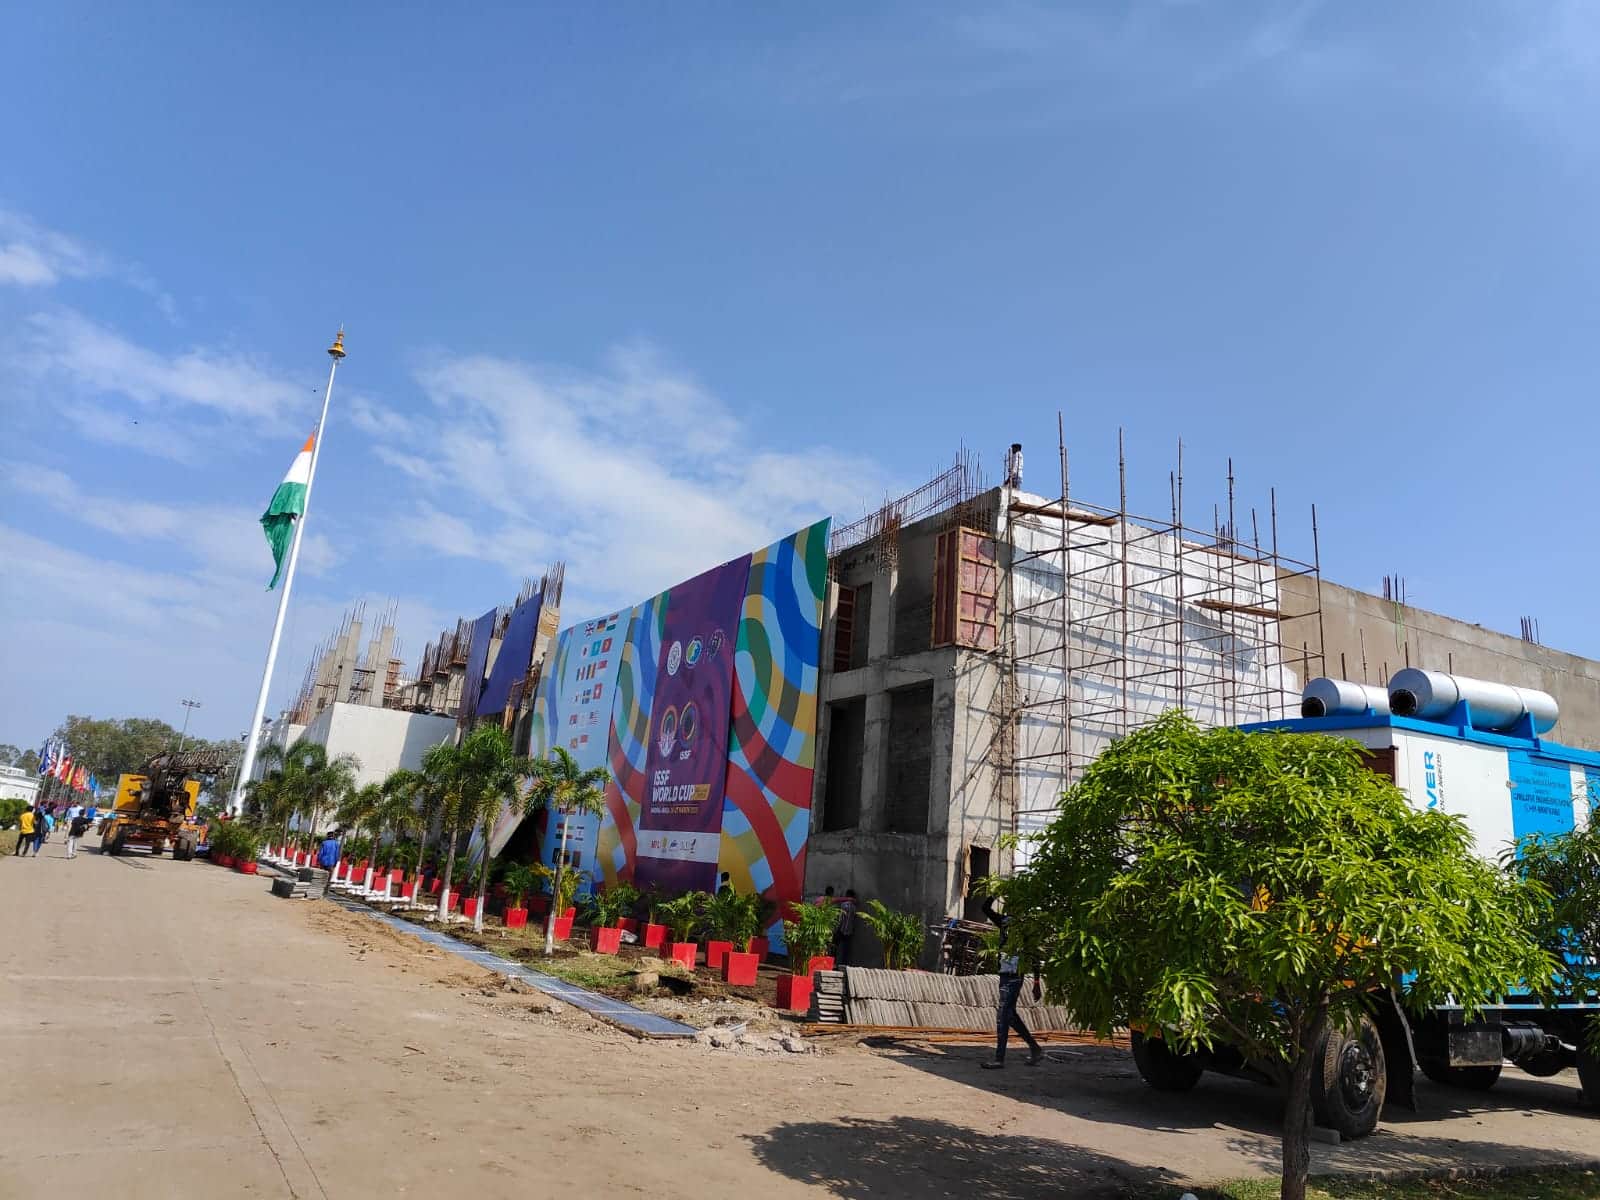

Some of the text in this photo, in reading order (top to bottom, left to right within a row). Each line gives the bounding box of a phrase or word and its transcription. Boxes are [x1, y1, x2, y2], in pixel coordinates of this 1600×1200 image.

[654, 769, 670, 785] ISSF
[653, 785, 678, 802] WORLD
[678, 784, 695, 801] CUP
